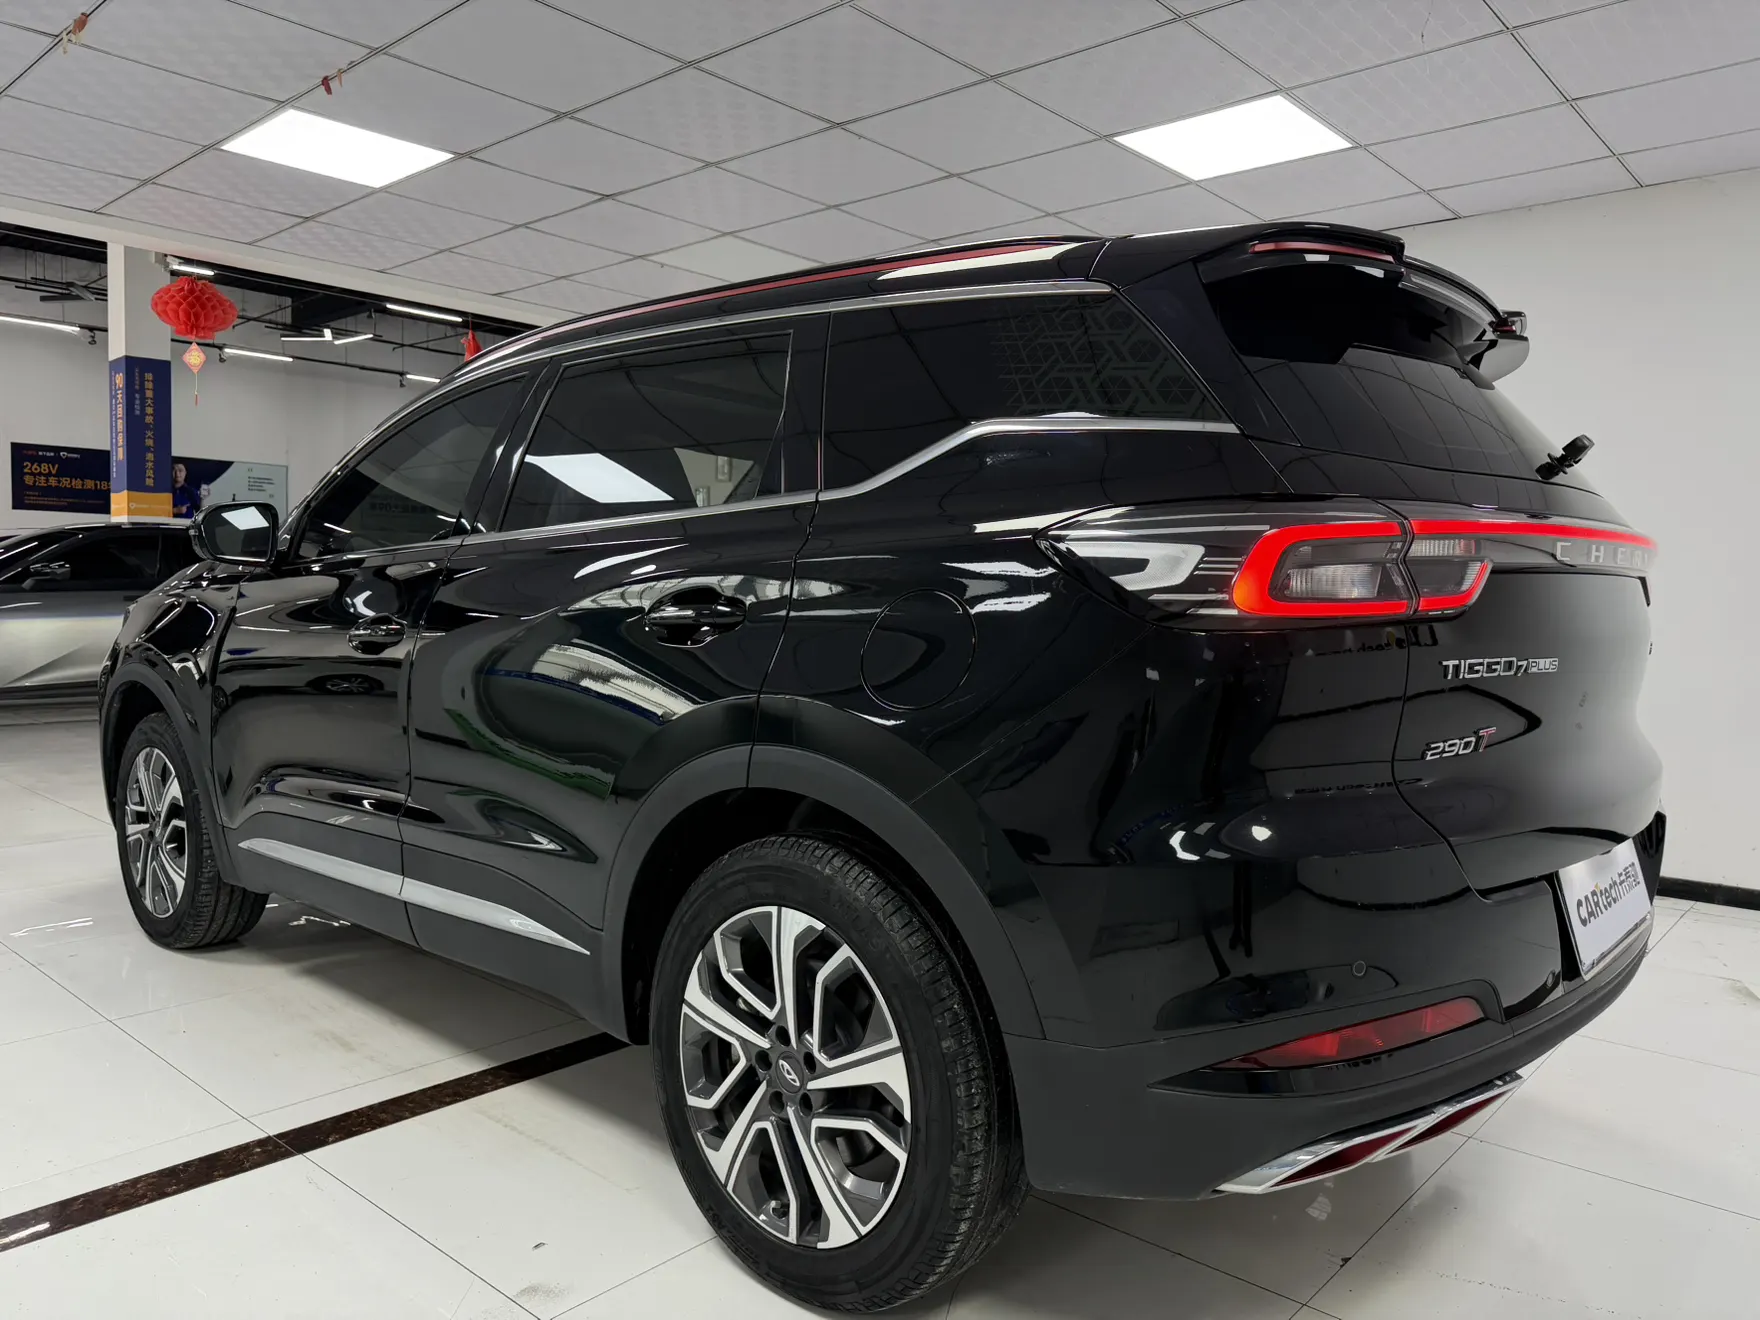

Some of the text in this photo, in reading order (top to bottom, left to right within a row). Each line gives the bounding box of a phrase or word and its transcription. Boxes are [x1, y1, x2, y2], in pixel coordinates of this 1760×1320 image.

[23, 462, 59, 474] 268V
[1529, 658, 1558, 673] PLUS
[1425, 727, 1496, 760] 290T
[1576, 877, 1622, 927] CARtech
